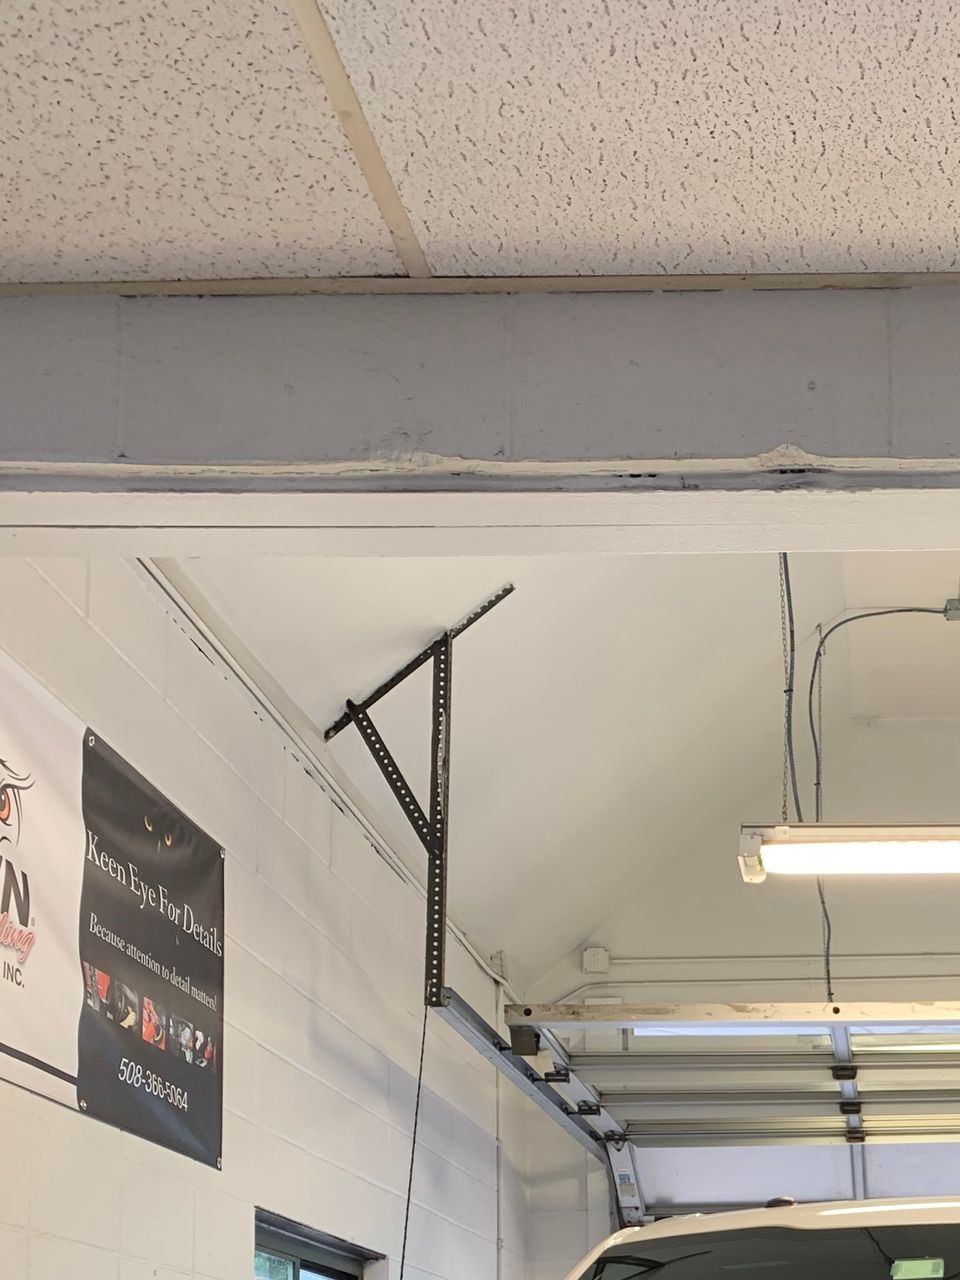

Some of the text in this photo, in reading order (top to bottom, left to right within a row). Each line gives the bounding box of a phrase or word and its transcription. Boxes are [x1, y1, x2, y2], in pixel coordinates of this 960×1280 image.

[87, 829, 222, 957] Keen Eye For Details
[3, 961, 25, 988] INC.
[89, 912, 217, 1012] Because attention to detail matters!
[118, 1057, 188, 1112] 508-366-5064
